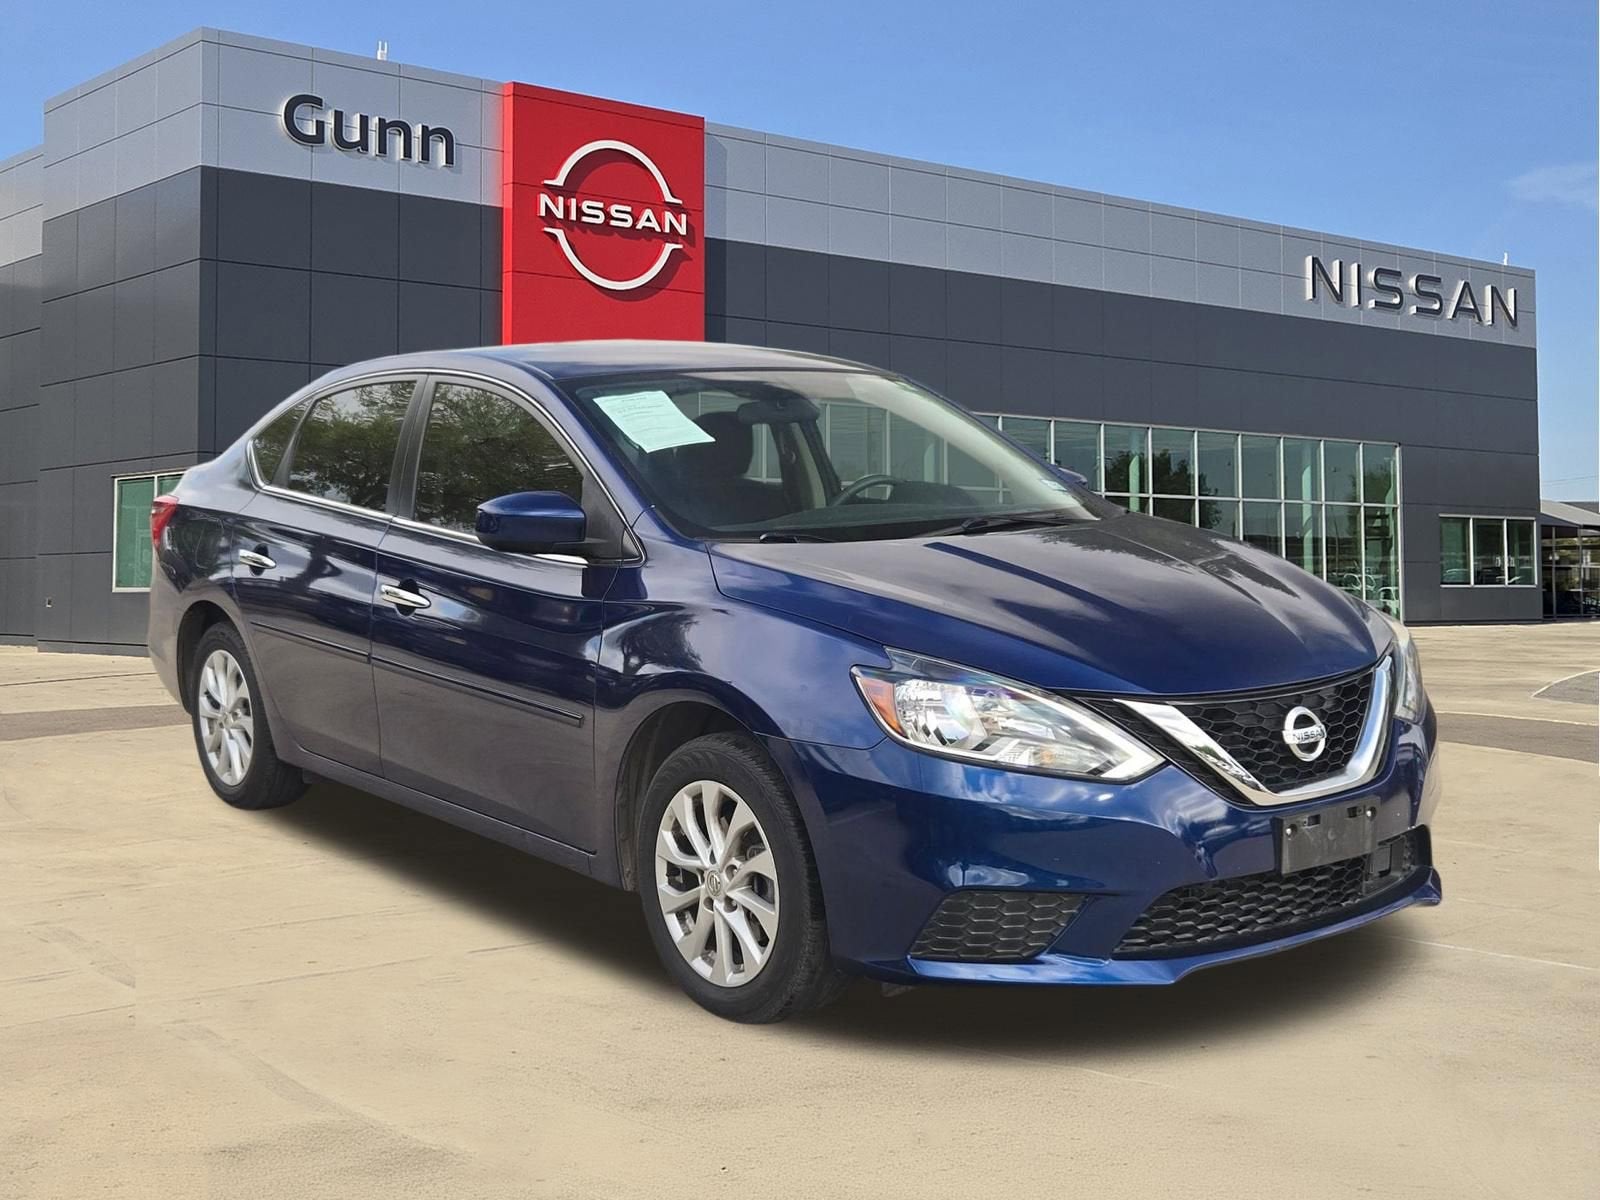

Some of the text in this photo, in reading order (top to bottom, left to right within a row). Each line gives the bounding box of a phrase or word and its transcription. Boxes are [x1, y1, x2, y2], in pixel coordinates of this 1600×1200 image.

[283, 94, 454, 167] Gunn
[538, 193, 687, 235] NISSAN
[1306, 256, 1517, 327] NISSAN
[1292, 728, 1325, 741] NISSAN
